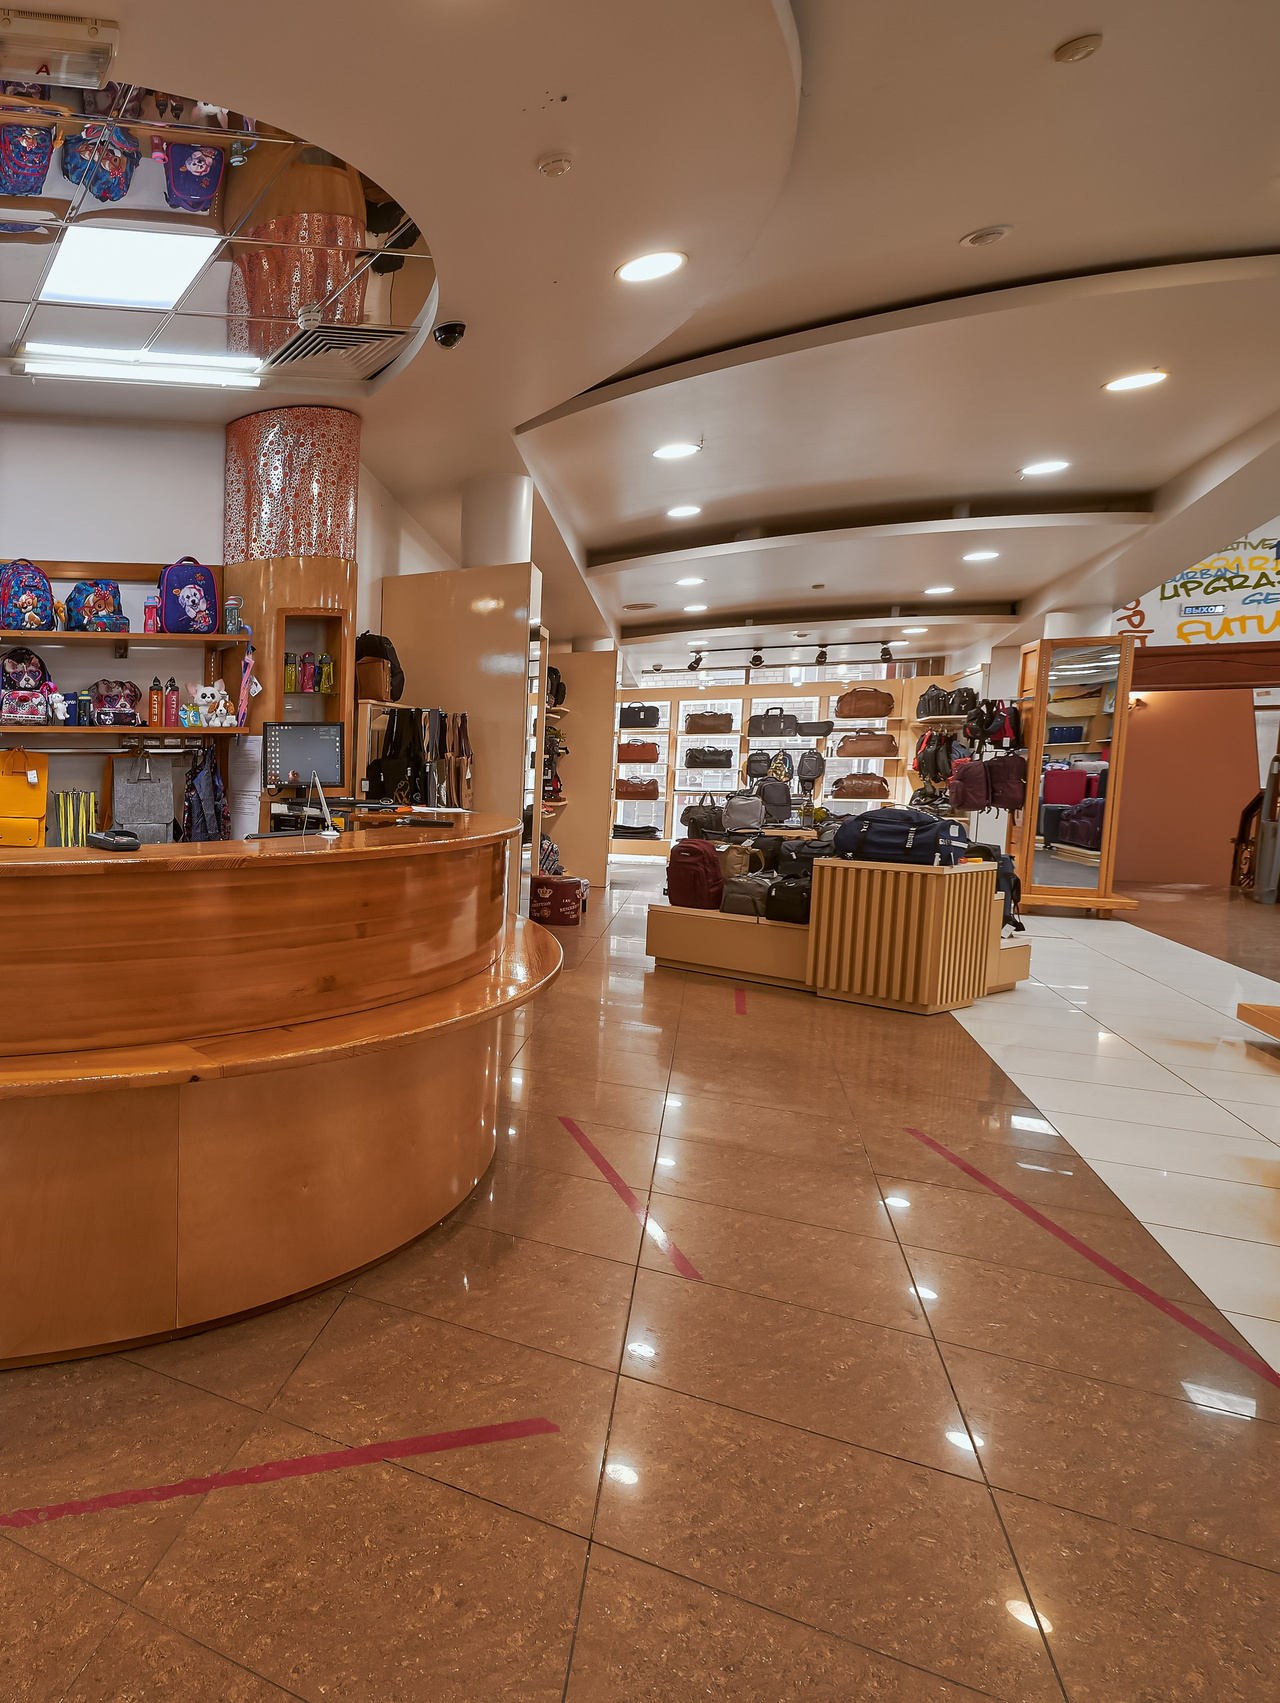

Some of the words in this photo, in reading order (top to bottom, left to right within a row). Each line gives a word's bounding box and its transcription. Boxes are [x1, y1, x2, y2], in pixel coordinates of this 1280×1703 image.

[35, 64, 50, 76] A
[1166, 563, 1240, 583] URBAN
[1160, 571, 1280, 601] UPGRA
[1185, 605, 1225, 614] ВЫХОД
